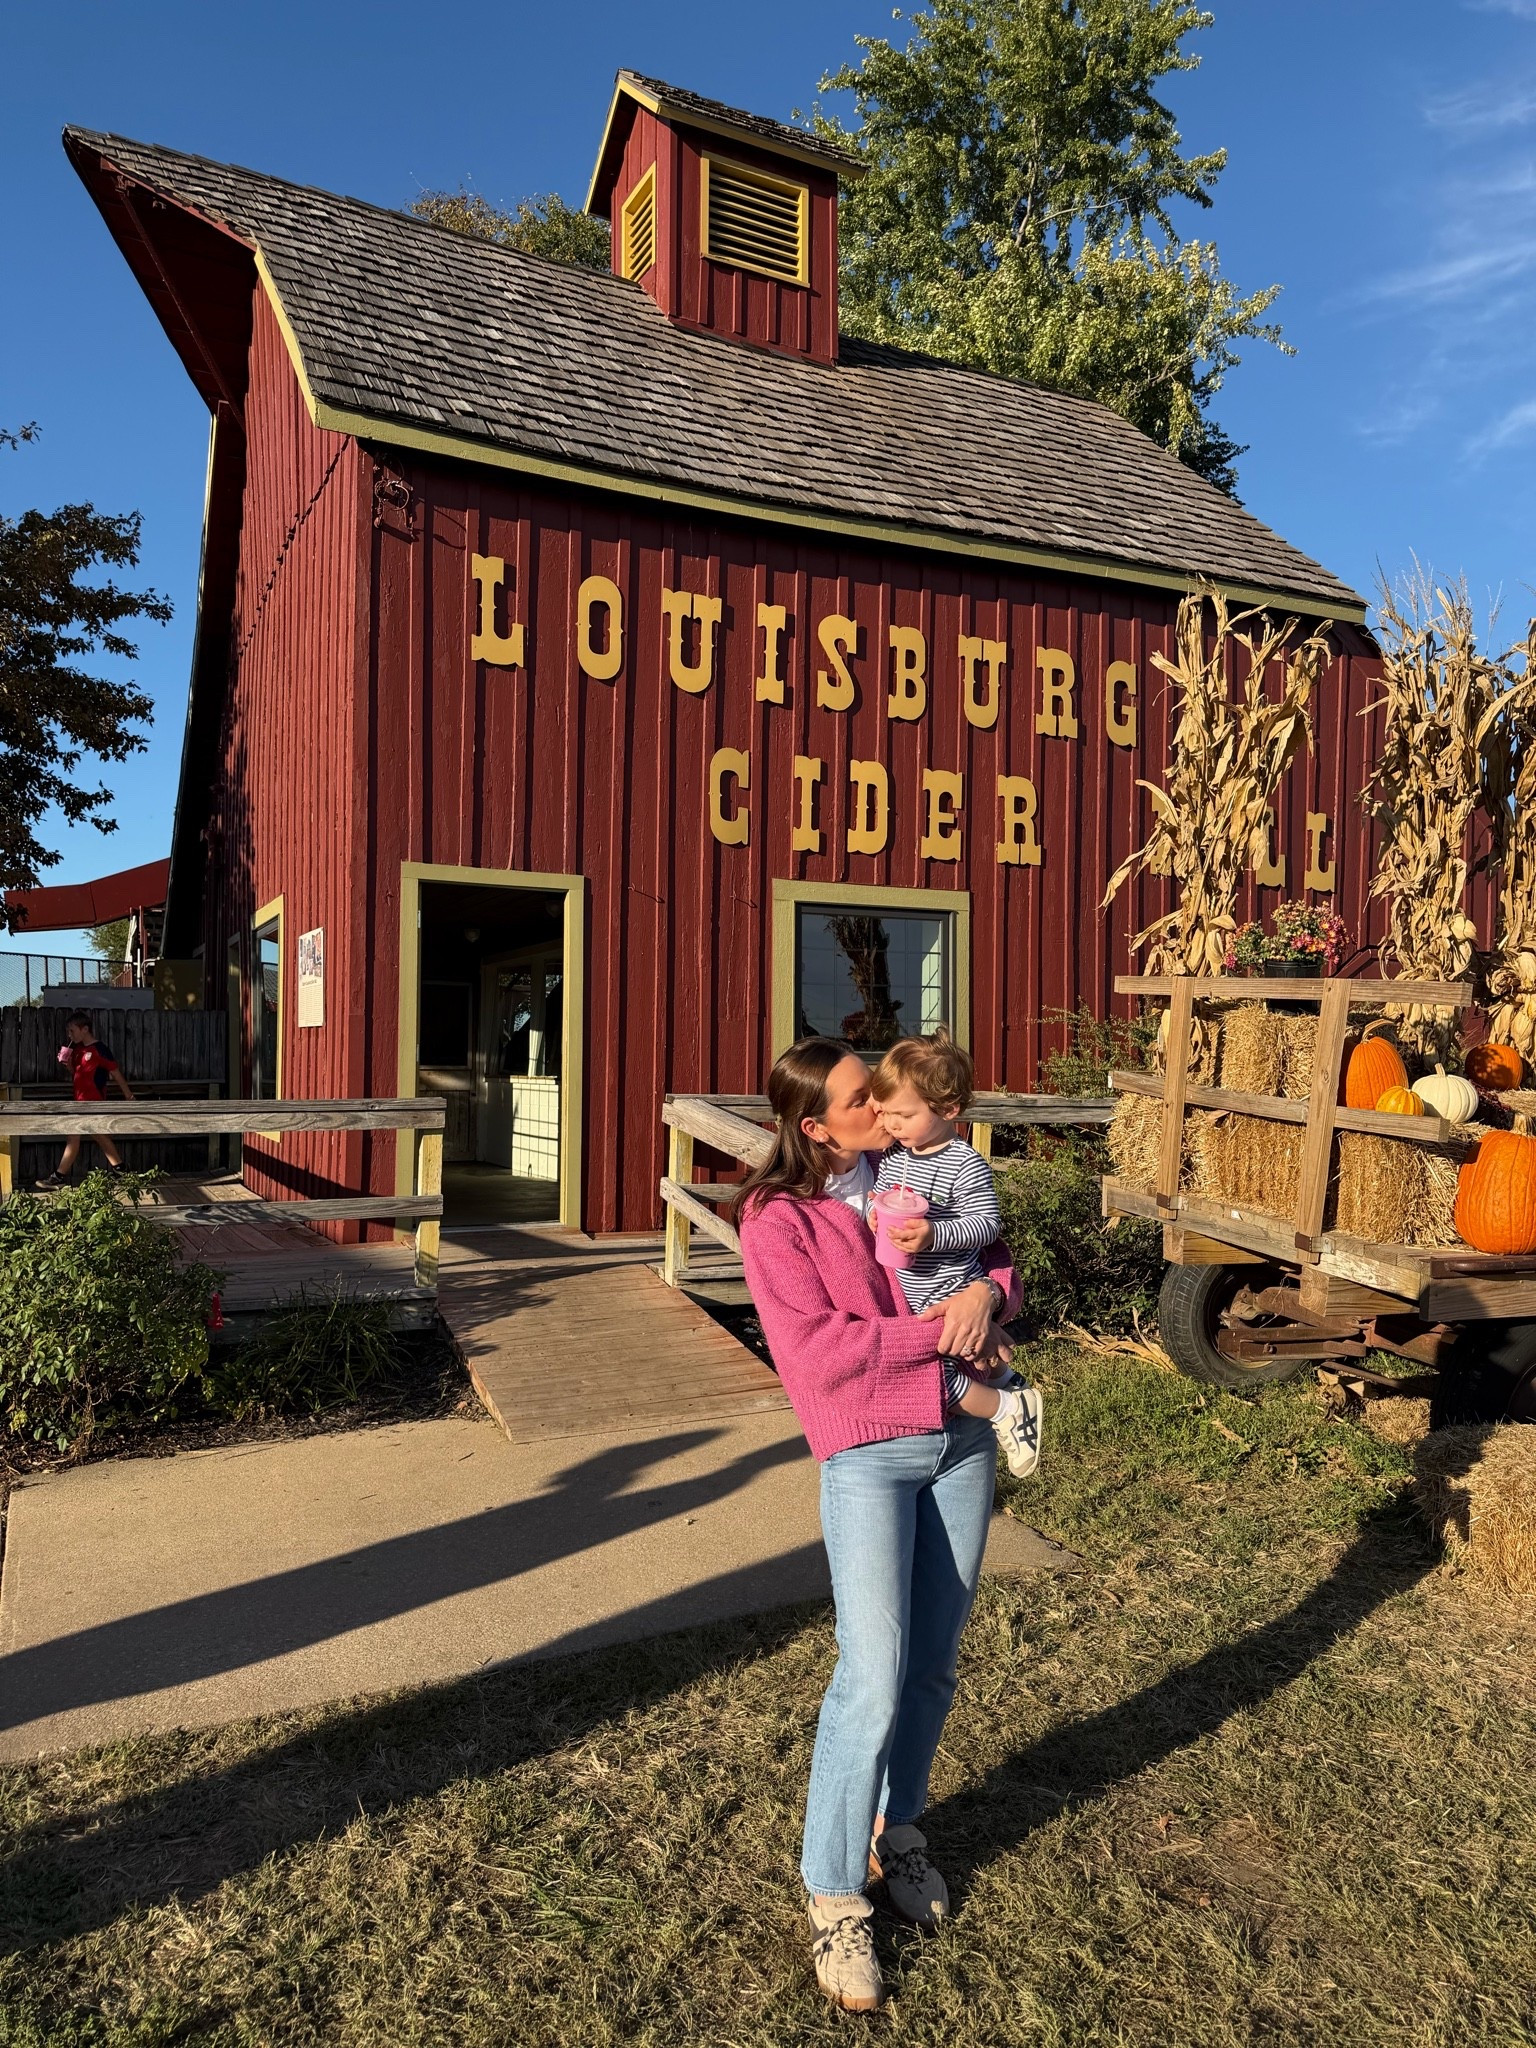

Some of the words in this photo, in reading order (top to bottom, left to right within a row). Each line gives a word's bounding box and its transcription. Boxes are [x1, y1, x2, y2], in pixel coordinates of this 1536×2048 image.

[471, 553, 1137, 747] LOUISBURG
[709, 747, 1042, 865] CIDER
[1150, 788, 1335, 892] LL
[834, 1898, 859, 1909] Gola
